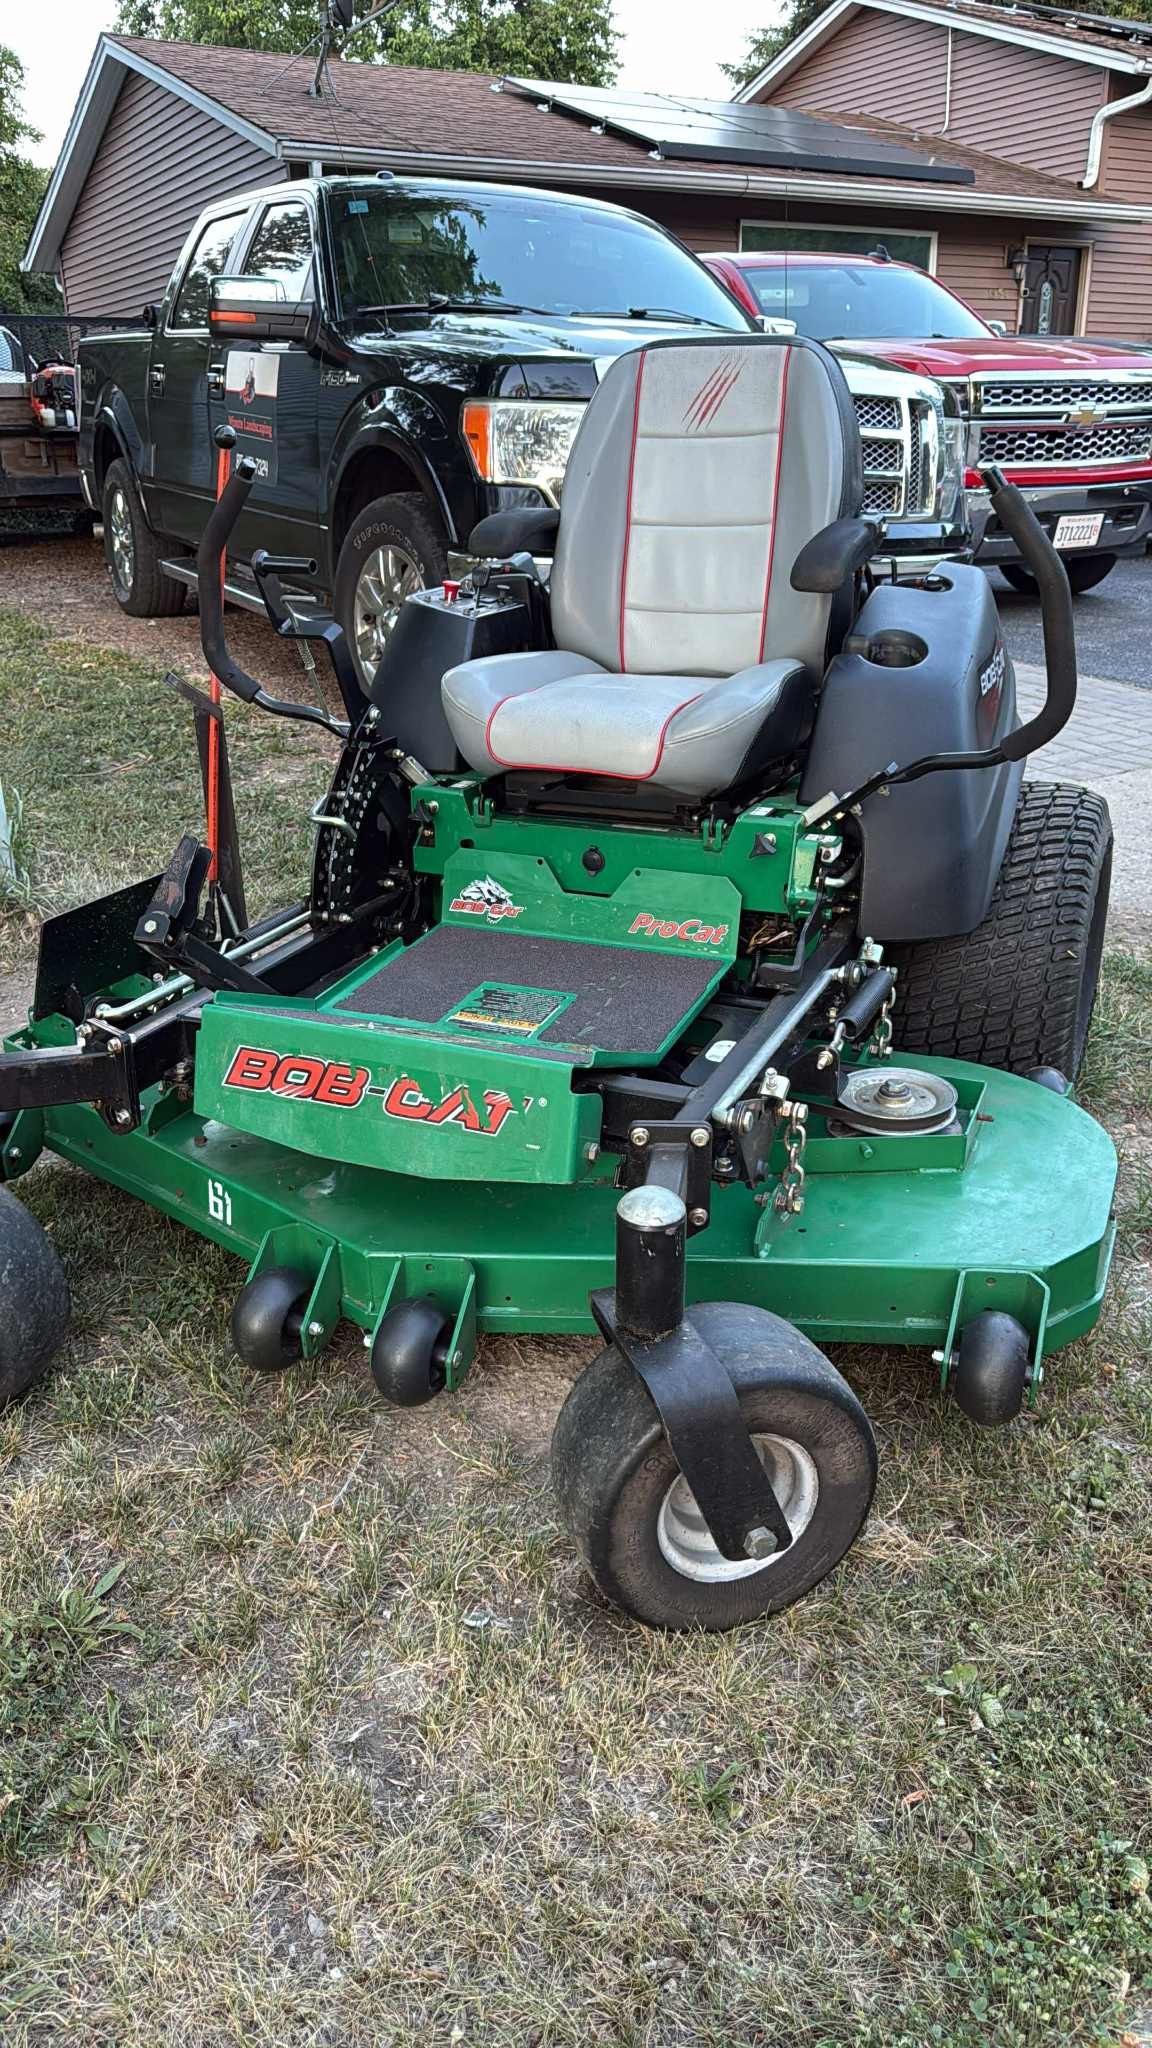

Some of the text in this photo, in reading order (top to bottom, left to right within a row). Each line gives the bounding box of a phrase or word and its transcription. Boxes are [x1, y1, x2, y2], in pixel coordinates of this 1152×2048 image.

[628, 912, 729, 944] ProCat
[222, 1046, 518, 1137] BOB-CAT
[208, 1179, 232, 1226] 61
